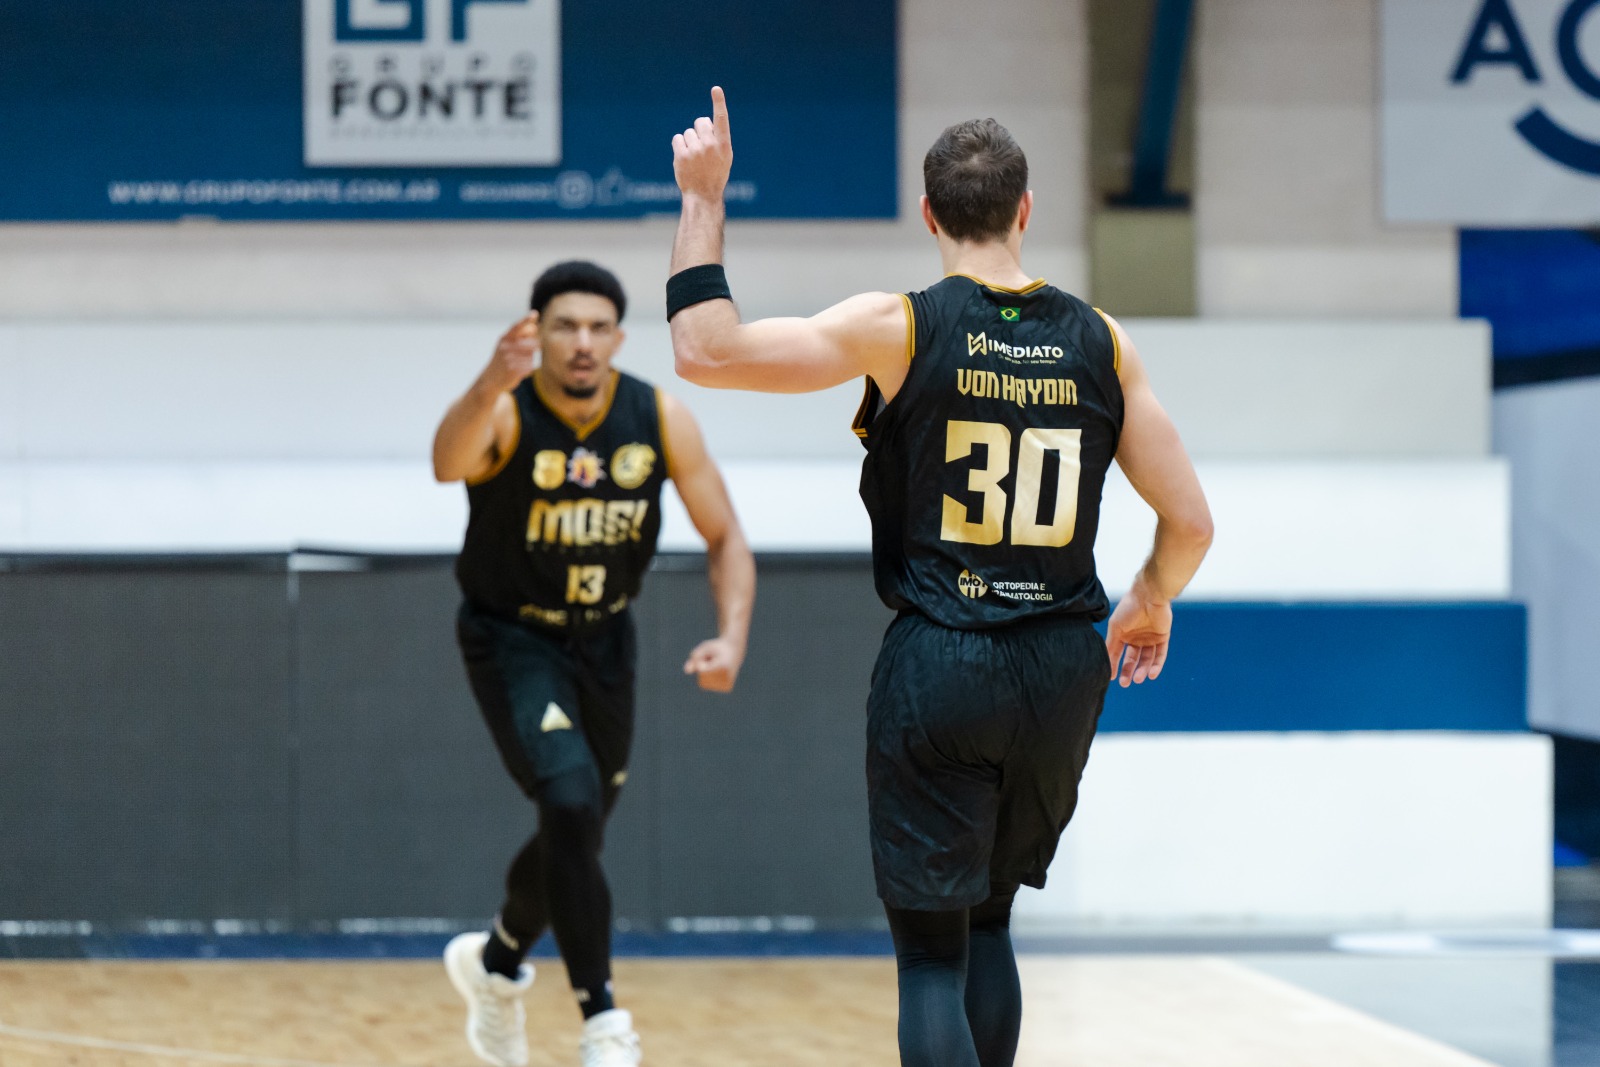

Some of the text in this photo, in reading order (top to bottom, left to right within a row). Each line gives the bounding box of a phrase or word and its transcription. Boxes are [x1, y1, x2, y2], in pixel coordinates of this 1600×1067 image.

[331, 79, 532, 121] FONTE
[988, 339, 1064, 359] IMEDIATO
[940, 420, 1082, 548] 30
[566, 564, 607, 605] 13
[992, 581, 1046, 591] ORTOPEDIA E
